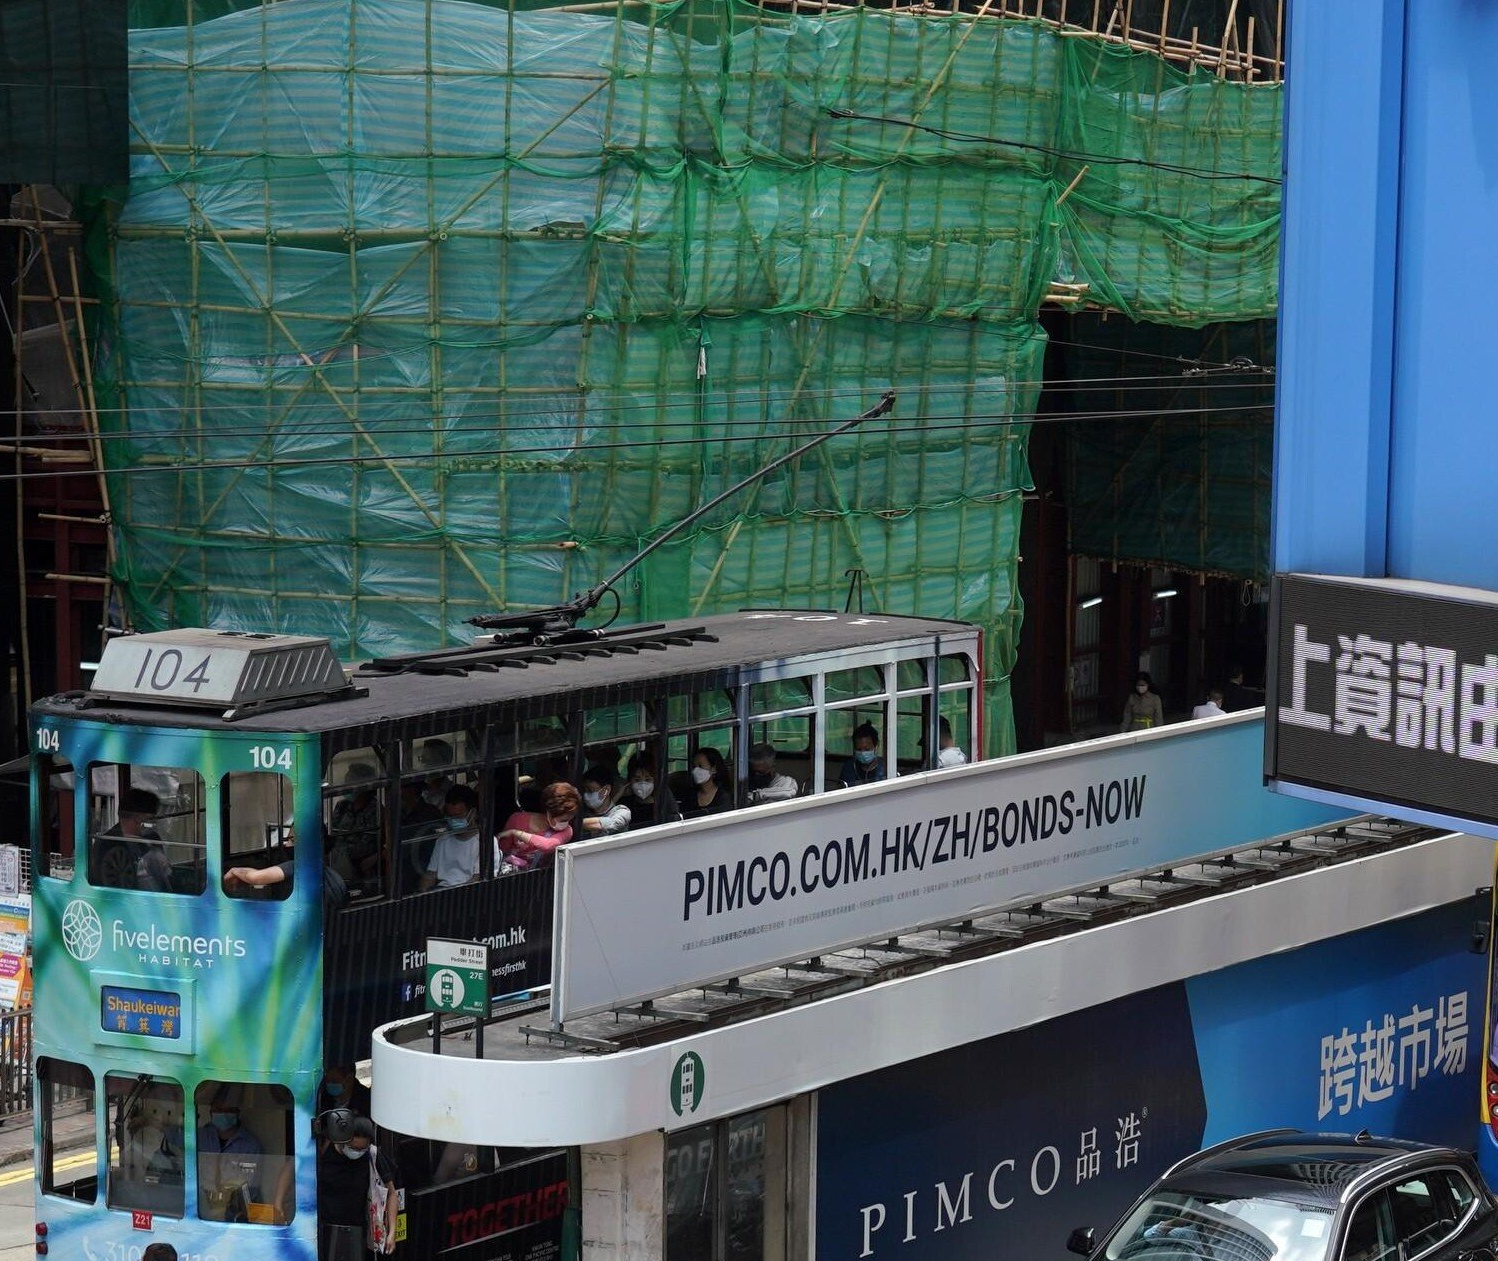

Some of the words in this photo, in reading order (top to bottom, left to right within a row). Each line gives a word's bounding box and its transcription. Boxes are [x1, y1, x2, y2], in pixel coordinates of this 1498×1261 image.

[134, 647, 212, 693] 104
[36, 727, 60, 752] 104
[249, 745, 293, 770] 104
[682, 774, 1147, 922] PIMCO.COM.HK/ZH/BONDS-NOW
[112, 919, 246, 957] fivelements
[138, 953, 215, 969] HABITAT
[469, 971, 484, 981] 27E
[1317, 990, 1469, 1122] 跨越市場
[859, 1143, 1061, 1259] PIMCO
[134, 1213, 150, 1226] Z21
